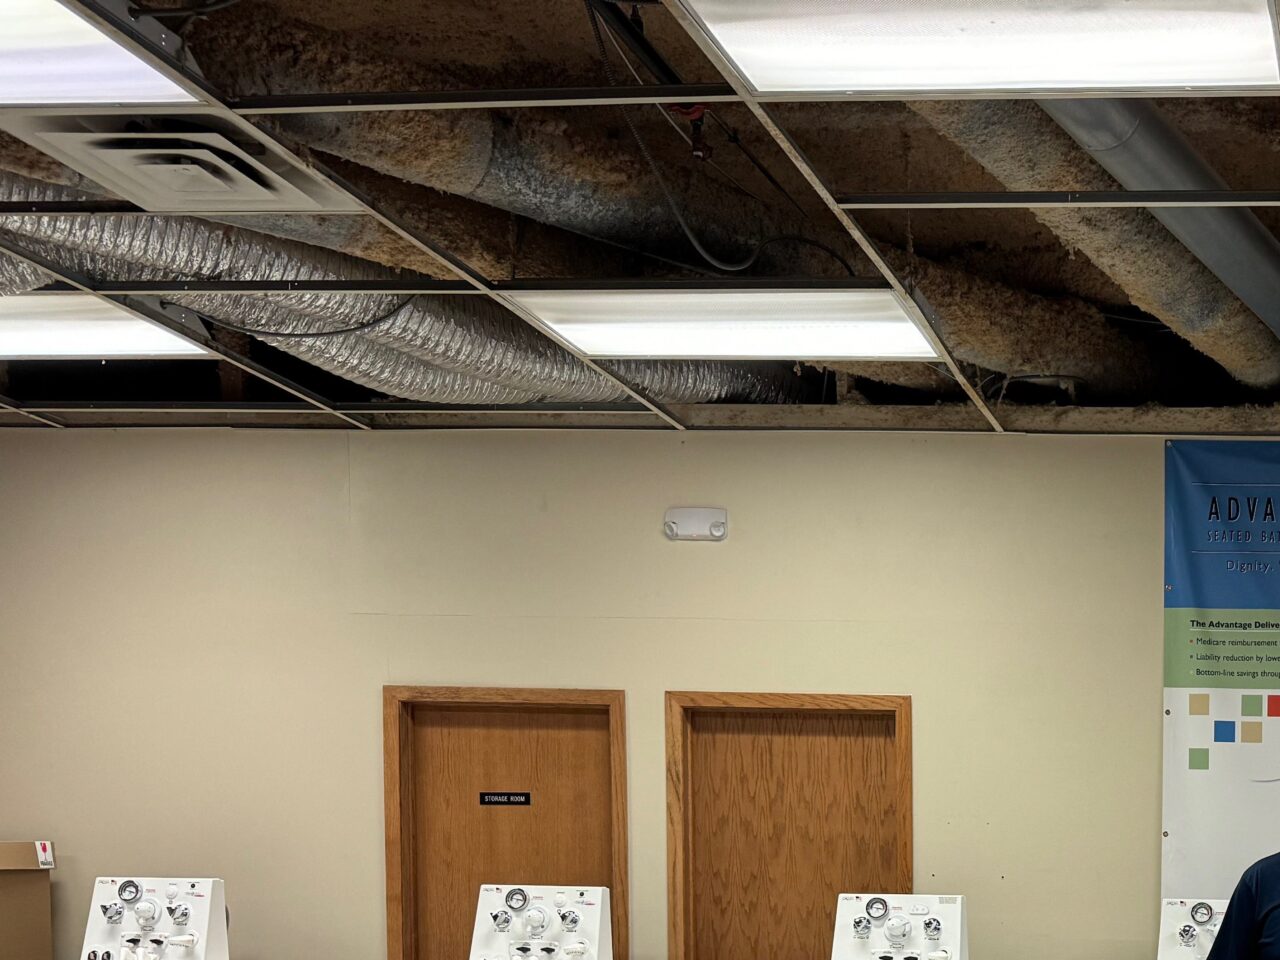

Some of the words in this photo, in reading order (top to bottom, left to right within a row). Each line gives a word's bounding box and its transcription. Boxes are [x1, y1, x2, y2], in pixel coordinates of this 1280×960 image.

[1207, 530, 1251, 543] SEATED
[1226, 559, 1274, 574] Dignity.
[1190, 620, 1206, 628] The
[1208, 620, 1252, 630] Advantage
[1196, 638, 1226, 646] Medicare
[1196, 653, 1221, 662] Liability
[1222, 654, 1254, 662] reduction
[1255, 654, 1264, 663] by
[1195, 668, 1235, 677] Bottom-line
[1236, 670, 1259, 679] savings
